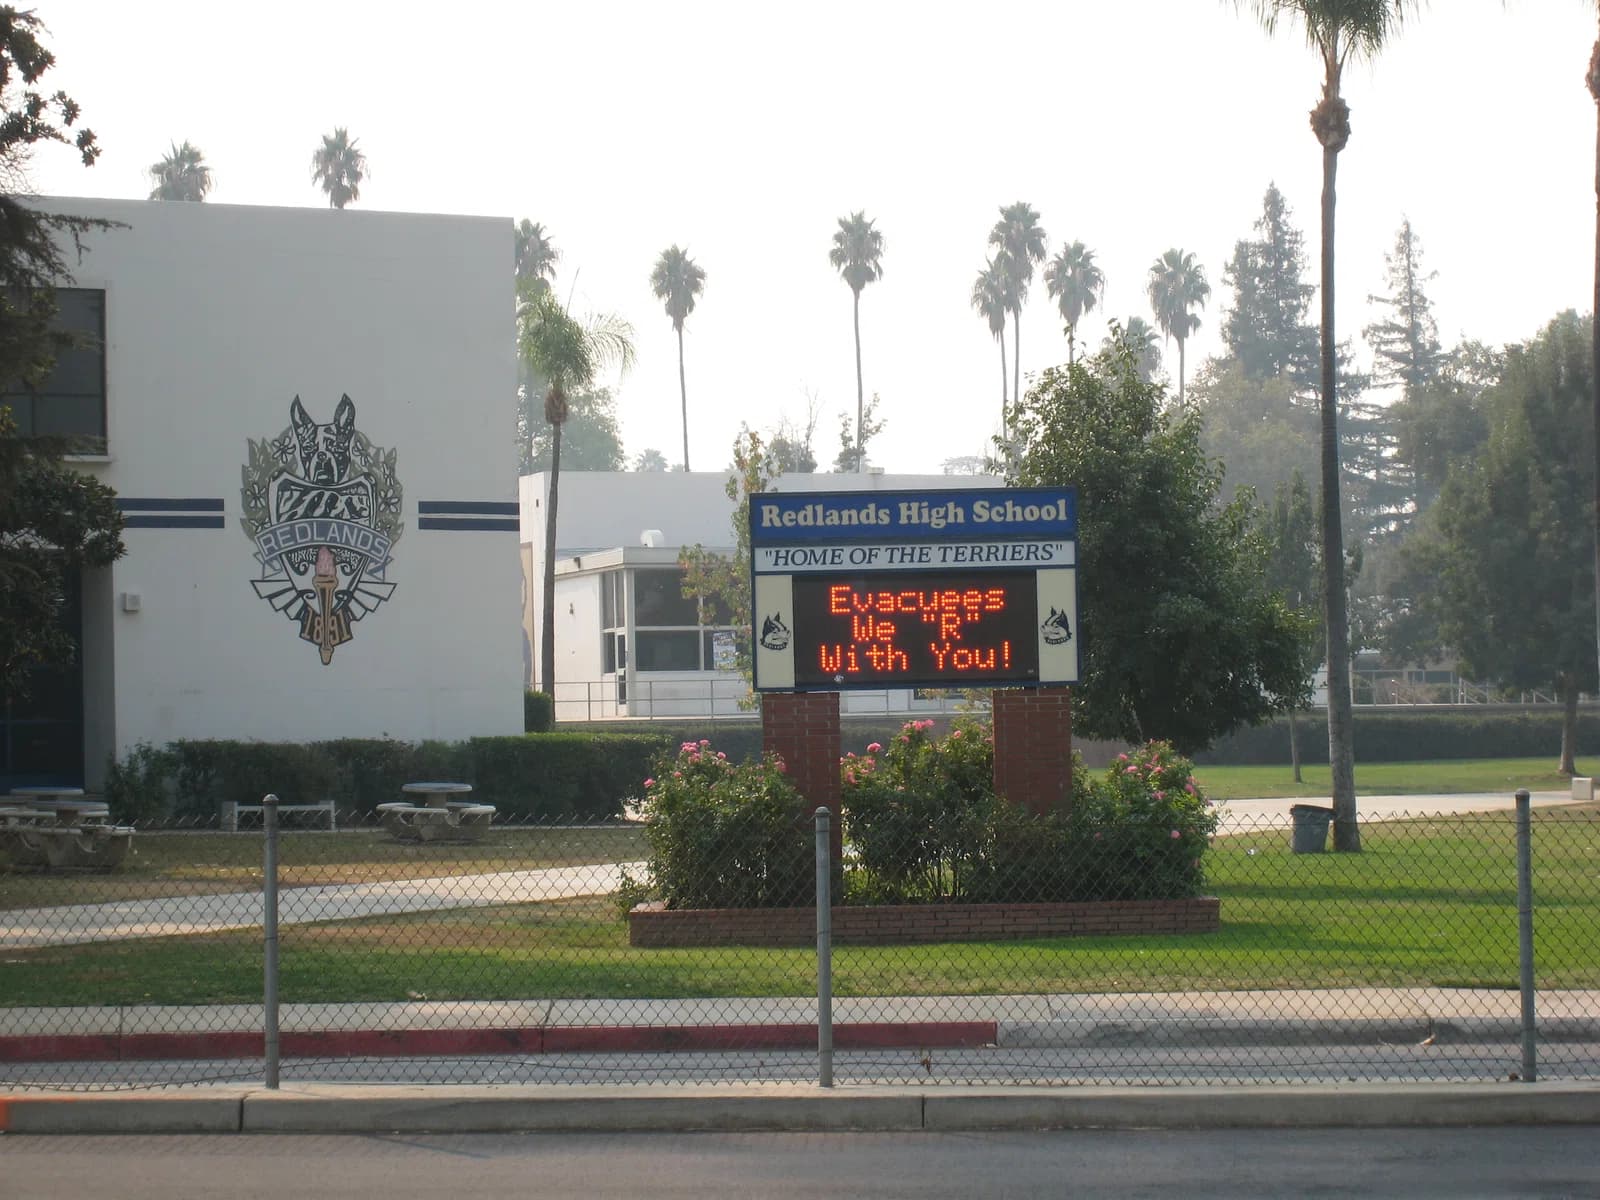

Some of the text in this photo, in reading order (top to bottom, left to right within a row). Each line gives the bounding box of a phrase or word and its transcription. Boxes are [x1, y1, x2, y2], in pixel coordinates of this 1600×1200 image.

[761, 499, 1067, 528] Redlands High School
[260, 521, 389, 558] REDLANDS
[765, 543, 1063, 566] "HOME OF THE TERRIERS"
[830, 585, 1005, 613] Evacuees
[302, 608, 351, 643] 1891
[852, 612, 980, 641] We "R"
[820, 640, 1010, 672] With You!
